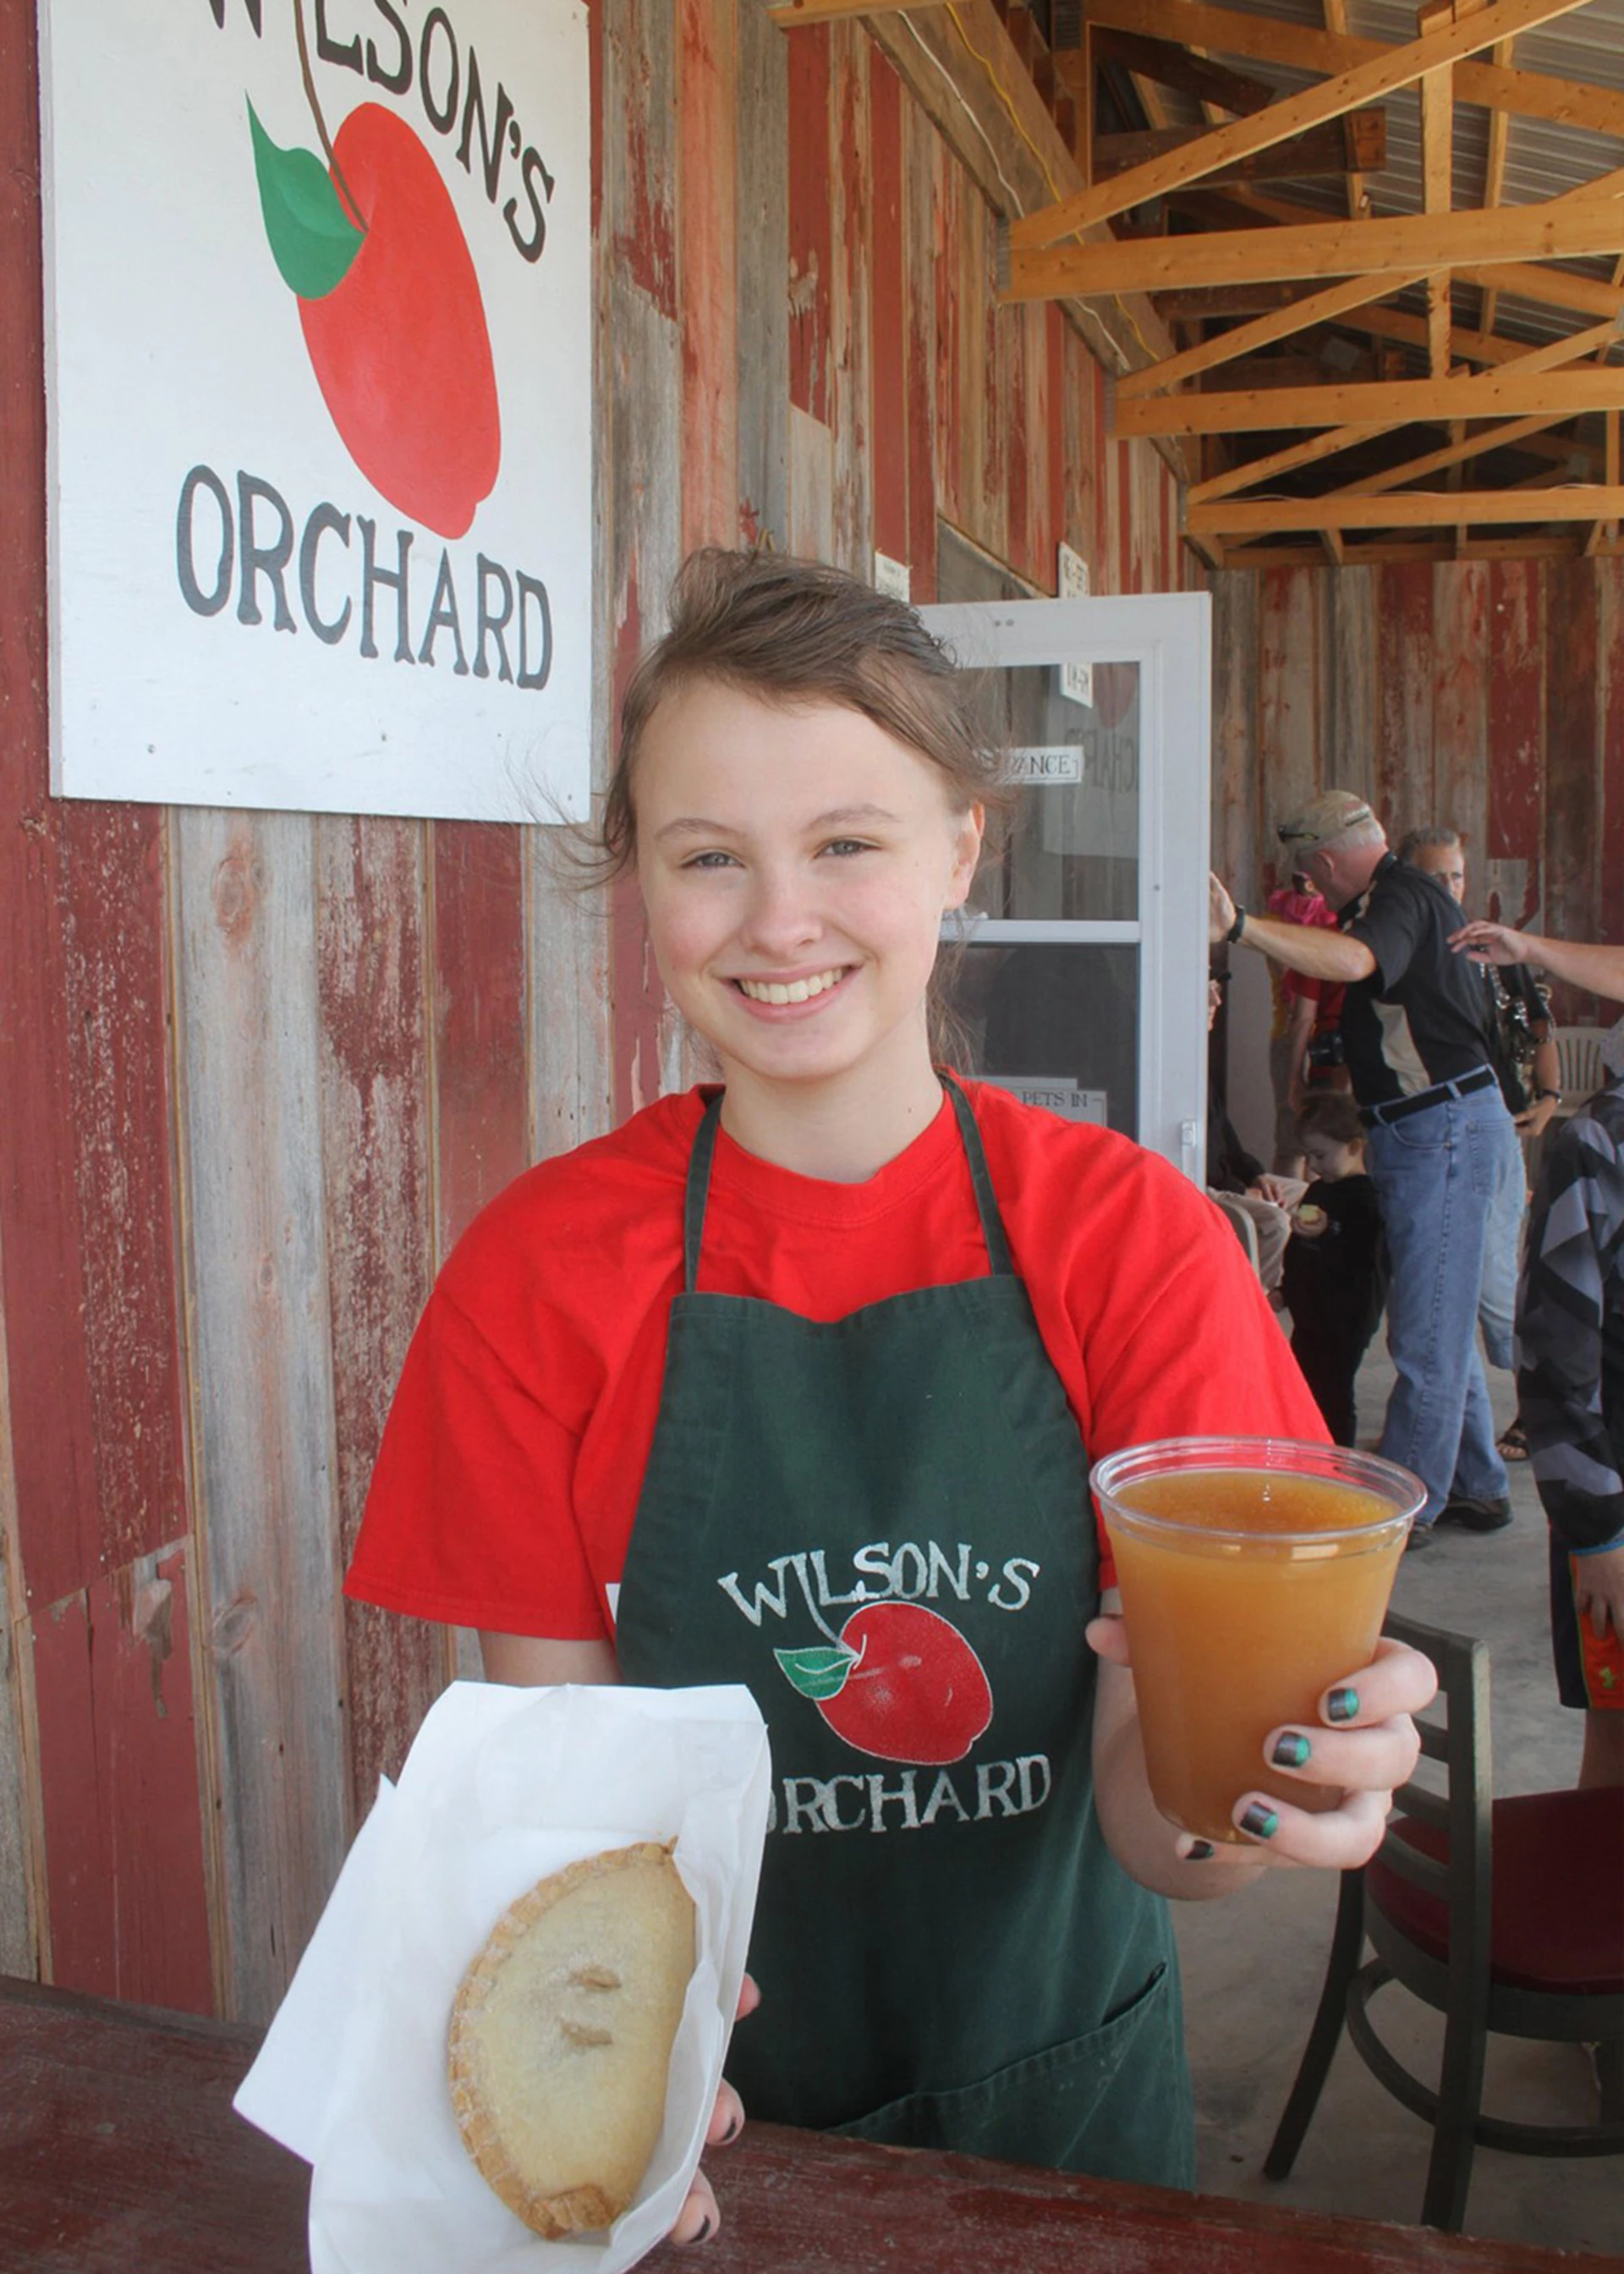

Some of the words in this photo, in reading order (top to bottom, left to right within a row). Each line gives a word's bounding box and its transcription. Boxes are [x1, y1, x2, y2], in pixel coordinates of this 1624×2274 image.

[176, 464, 552, 690] ORCHARD
[1022, 1091, 1065, 1107] PETS
[1071, 1093, 1088, 1107] IN
[717, 1540, 1040, 1633] WILSON'S
[767, 1754, 1051, 1834] RCHARD
